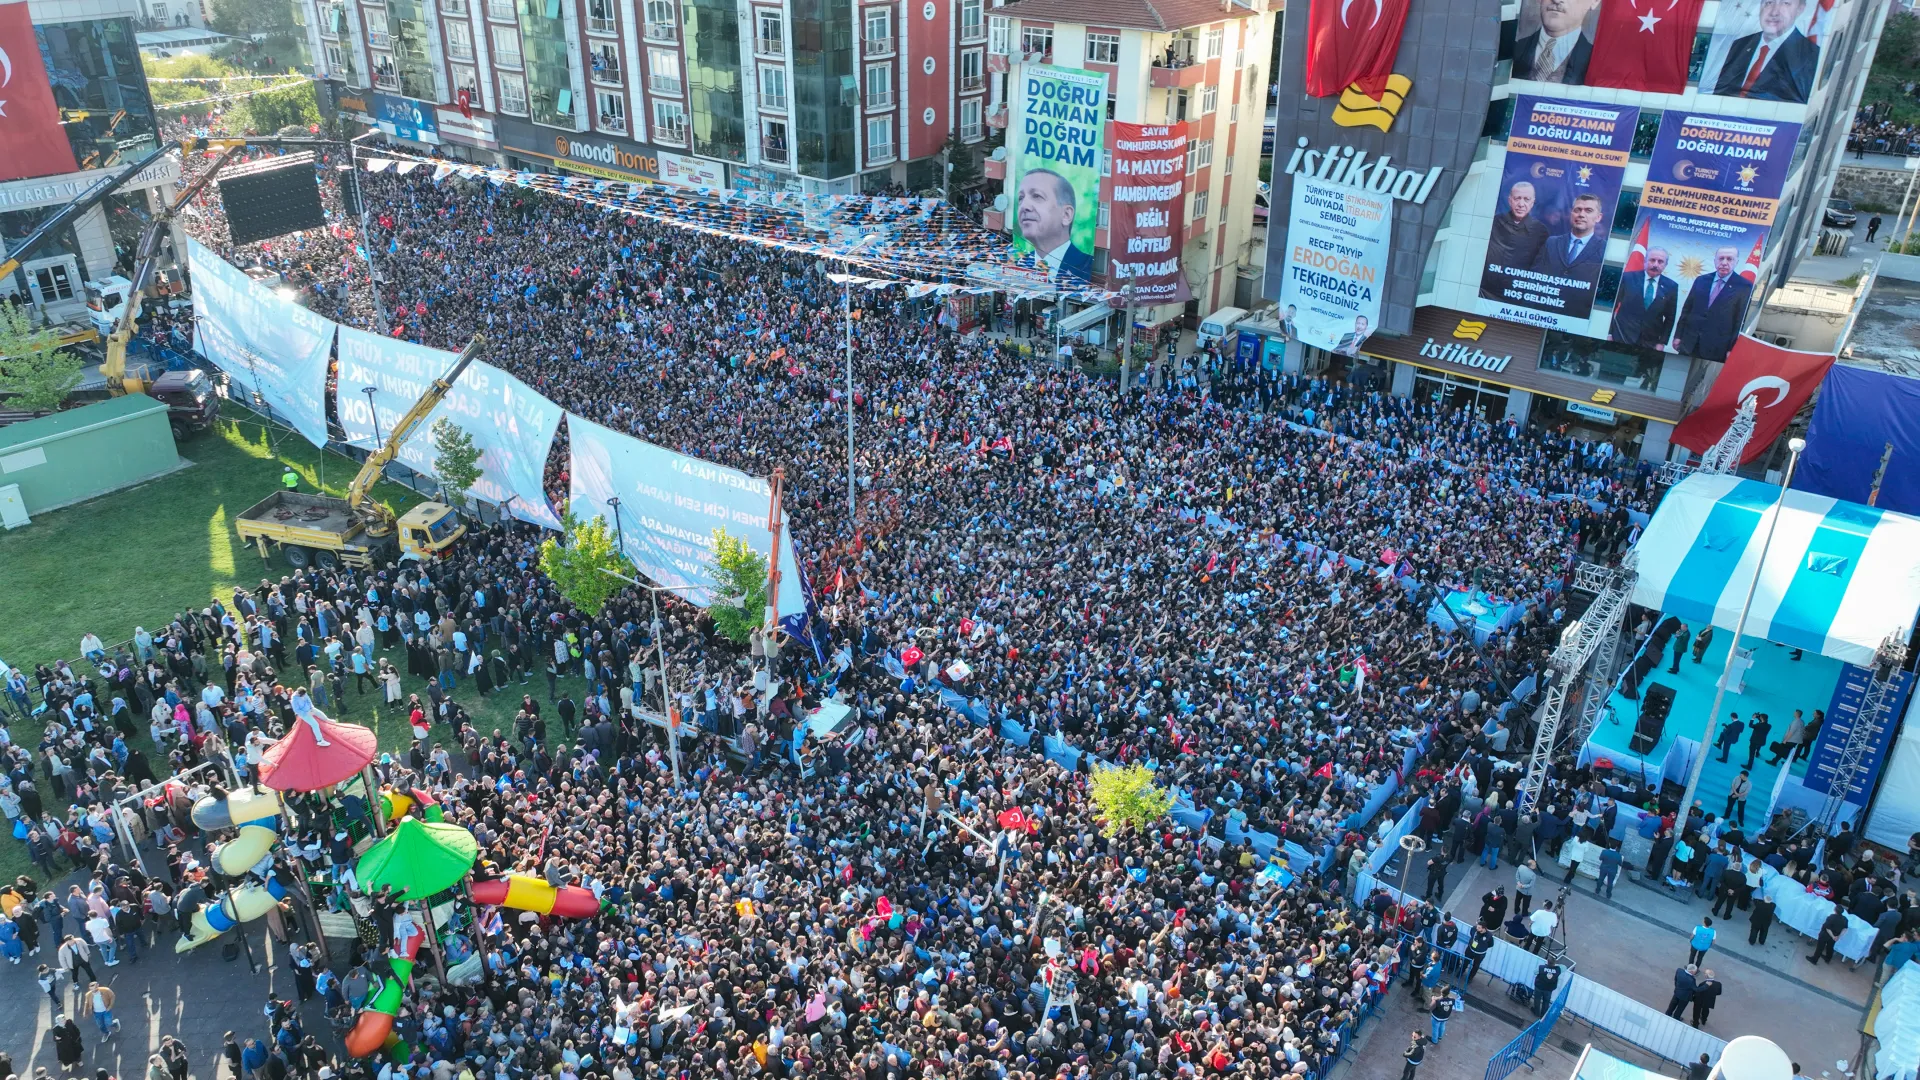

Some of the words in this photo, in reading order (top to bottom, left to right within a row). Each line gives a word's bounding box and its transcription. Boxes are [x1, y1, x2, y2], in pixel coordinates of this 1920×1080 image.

[1028, 78, 1100, 107] DOĞRU
[1026, 97, 1098, 125] ZAMAN
[1025, 118, 1096, 147] DOĞRU
[1531, 112, 1571, 126] DOĞRU
[1571, 118, 1616, 132] ZAMAN
[1528, 125, 1572, 139] DOĞRU
[1573, 131, 1613, 146] ADAM
[1680, 126, 1723, 141] DOĞRU
[1723, 132, 1772, 147] ZAMAN
[570, 141, 658, 174] mondihome
[1024, 137, 1095, 168] ADAM
[1513, 141, 1536, 150] DÜNYA
[1537, 143, 1569, 154] LİDERİNE
[1570, 150, 1594, 158] SELAM
[1595, 153, 1623, 162] OLSUN!
[1676, 139, 1724, 155] DOĞRU
[1724, 146, 1769, 161] ADAM
[1116, 158, 1130, 174] 14
[1285, 136, 1444, 204] istikbal
[65, 182, 83, 196] VE
[1305, 184, 1345, 201] TÜRKİYE'DE
[1649, 185, 1665, 194] SN.
[1667, 188, 1772, 210] CUMHURBAŞKANIMIZ
[1304, 194, 1344, 213] DÜNYADA
[1647, 195, 1697, 210] ŞEHRİMİZE
[1699, 203, 1720, 214] HOŞ
[1721, 207, 1769, 221] GELDİNİZ
[1136, 207, 1164, 228] DEĞİL
[1319, 210, 1357, 227] SEMBOLÜ
[1657, 214, 1676, 222] PROF.
[1688, 219, 1720, 229] MUSTAFA
[1720, 223, 1747, 233] ŞENTOP
[1668, 222, 1695, 233] TEKİRDAĞ
[1127, 235, 1172, 254] KÖFTELER
[1308, 237, 1335, 252] RECEP
[1336, 244, 1363, 260] TAYYİP
[1293, 245, 1376, 283] ERDOĞAN
[1488, 264, 1503, 274] SN.
[1504, 267, 1591, 290] CUMHURBAŞKANIM
[1152, 283, 1177, 293] ÖZCAN
[1299, 285, 1318, 299] HOŞ
[1319, 291, 1360, 312] GELDİNİZ
[1504, 289, 1523, 300] HOŞ
[1523, 293, 1566, 308] GELDİNİZ
[1512, 280, 1561, 296] ŞEHRİMİZE
[1499, 307, 1512, 316] AV.
[1513, 309, 1527, 319] ALİ
[1528, 313, 1558, 325] GÜMÜŞ
[1419, 337, 1513, 373] istikbal
